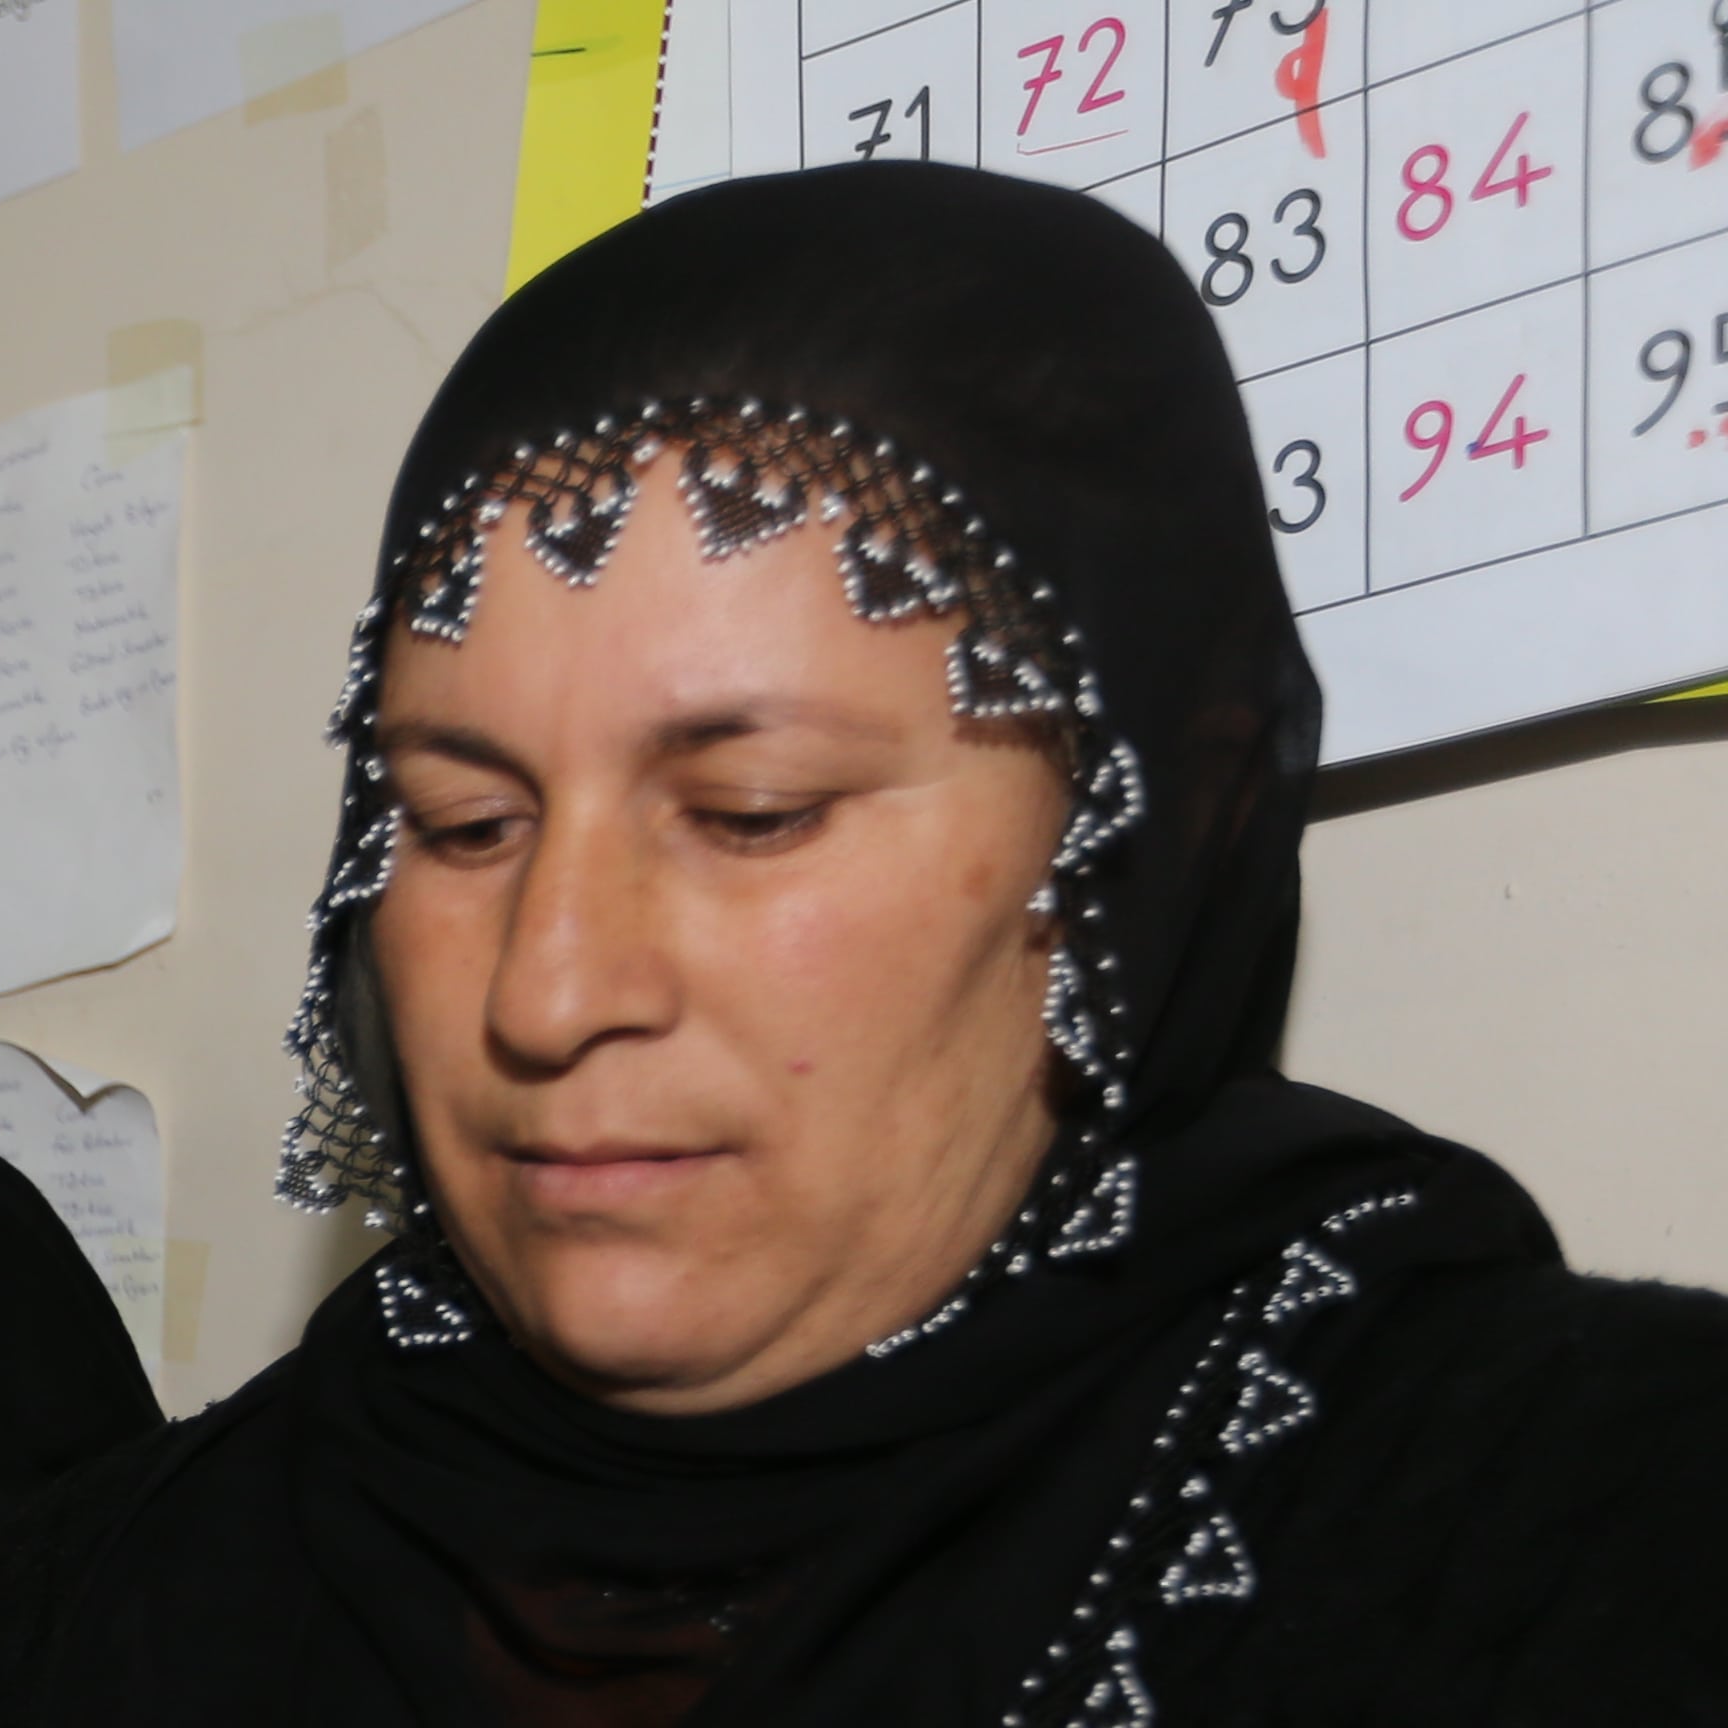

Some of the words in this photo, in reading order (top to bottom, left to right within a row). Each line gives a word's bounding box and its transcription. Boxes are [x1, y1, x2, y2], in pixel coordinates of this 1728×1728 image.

[848, 85, 930, 161] 71
[1017, 17, 1126, 136] 72
[1201, 188, 1326, 307] 83
[1397, 111, 1552, 242] 84
[1268, 439, 1326, 534] 3
[1398, 373, 1550, 502] 94
[1634, 313, 1728, 438] 9
